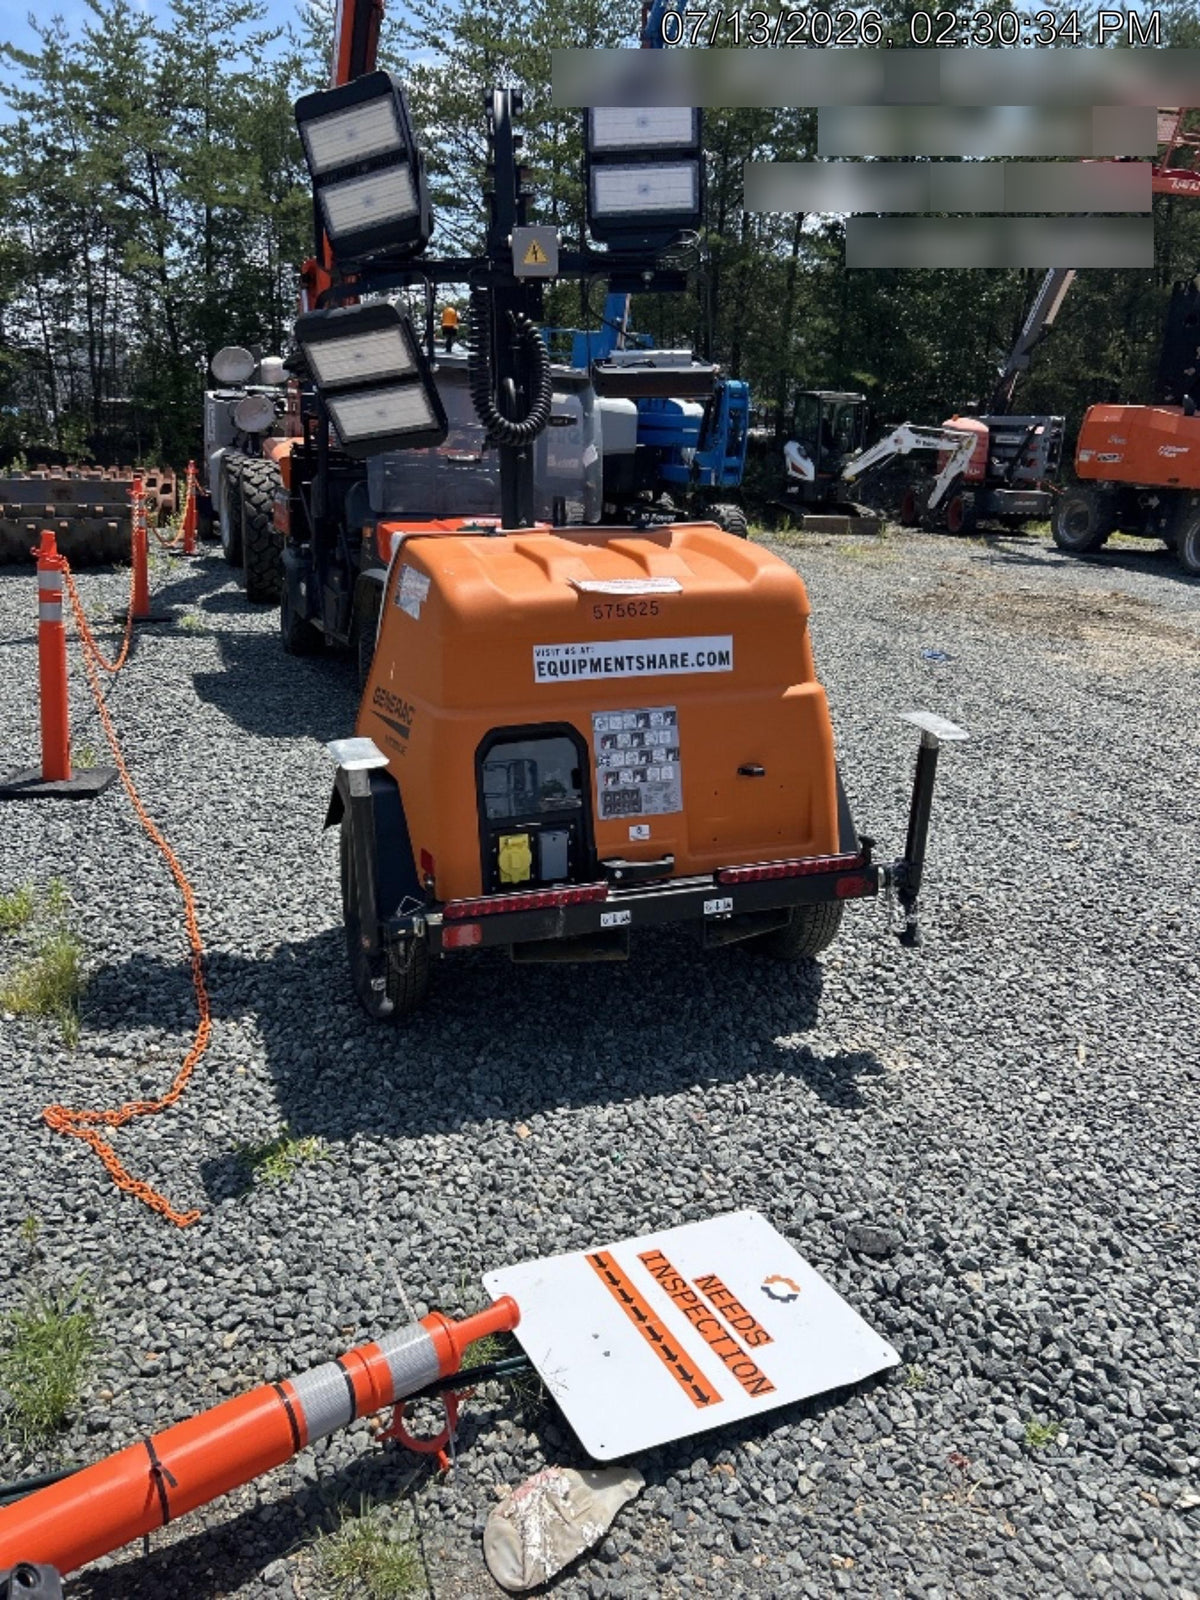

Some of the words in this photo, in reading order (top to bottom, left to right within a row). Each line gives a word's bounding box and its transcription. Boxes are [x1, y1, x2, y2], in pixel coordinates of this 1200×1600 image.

[593, 600, 659, 620] 575625
[535, 648, 560, 657] VISIT
[565, 647, 576, 655] US
[537, 651, 730, 678] EQUIPMENTSHARE.COM
[373, 686, 416, 725] GENERAC
[641, 1252, 775, 1397] INSPECTION
[694, 1274, 771, 1348] NEEDS
